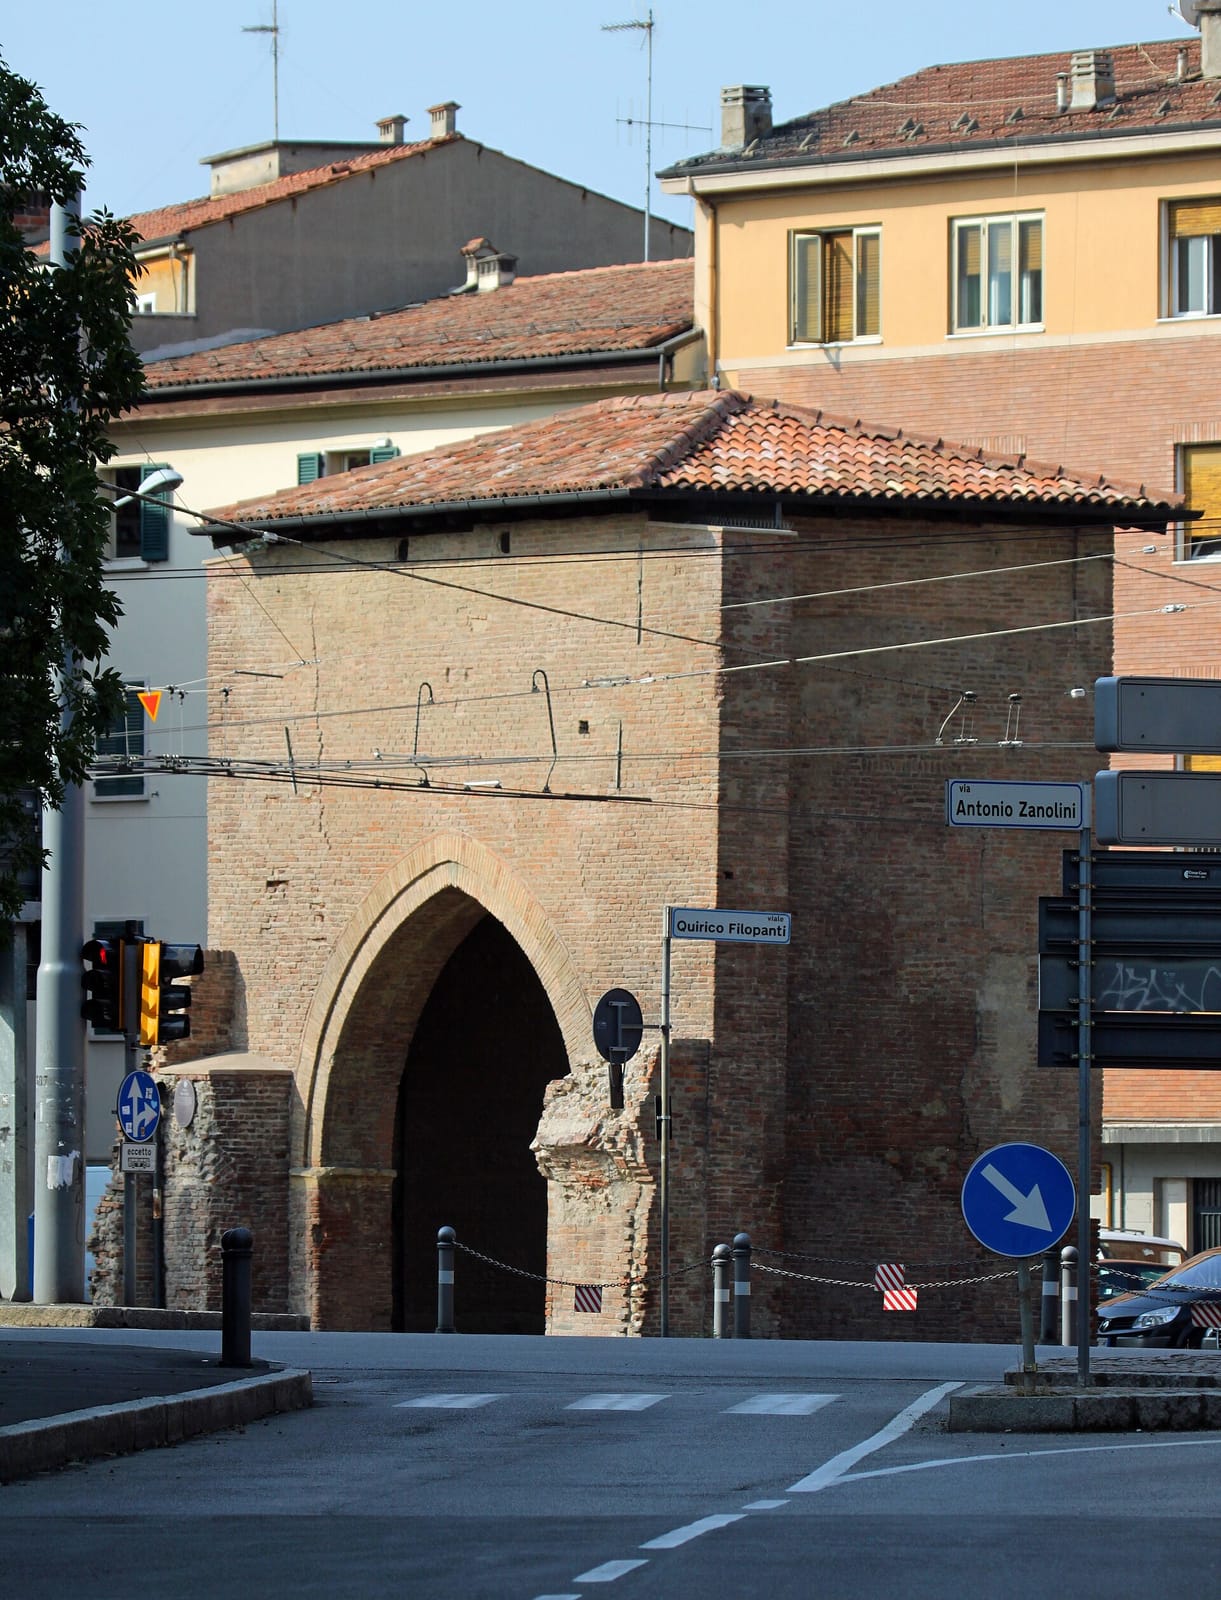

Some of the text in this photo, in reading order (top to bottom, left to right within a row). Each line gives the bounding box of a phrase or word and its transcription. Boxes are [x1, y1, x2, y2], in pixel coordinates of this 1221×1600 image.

[959, 784, 971, 793] via
[956, 800, 1076, 818] Antonio Zanolini
[677, 920, 787, 937] Quirico Filopanti
[127, 1148, 152, 1156] eccetto
